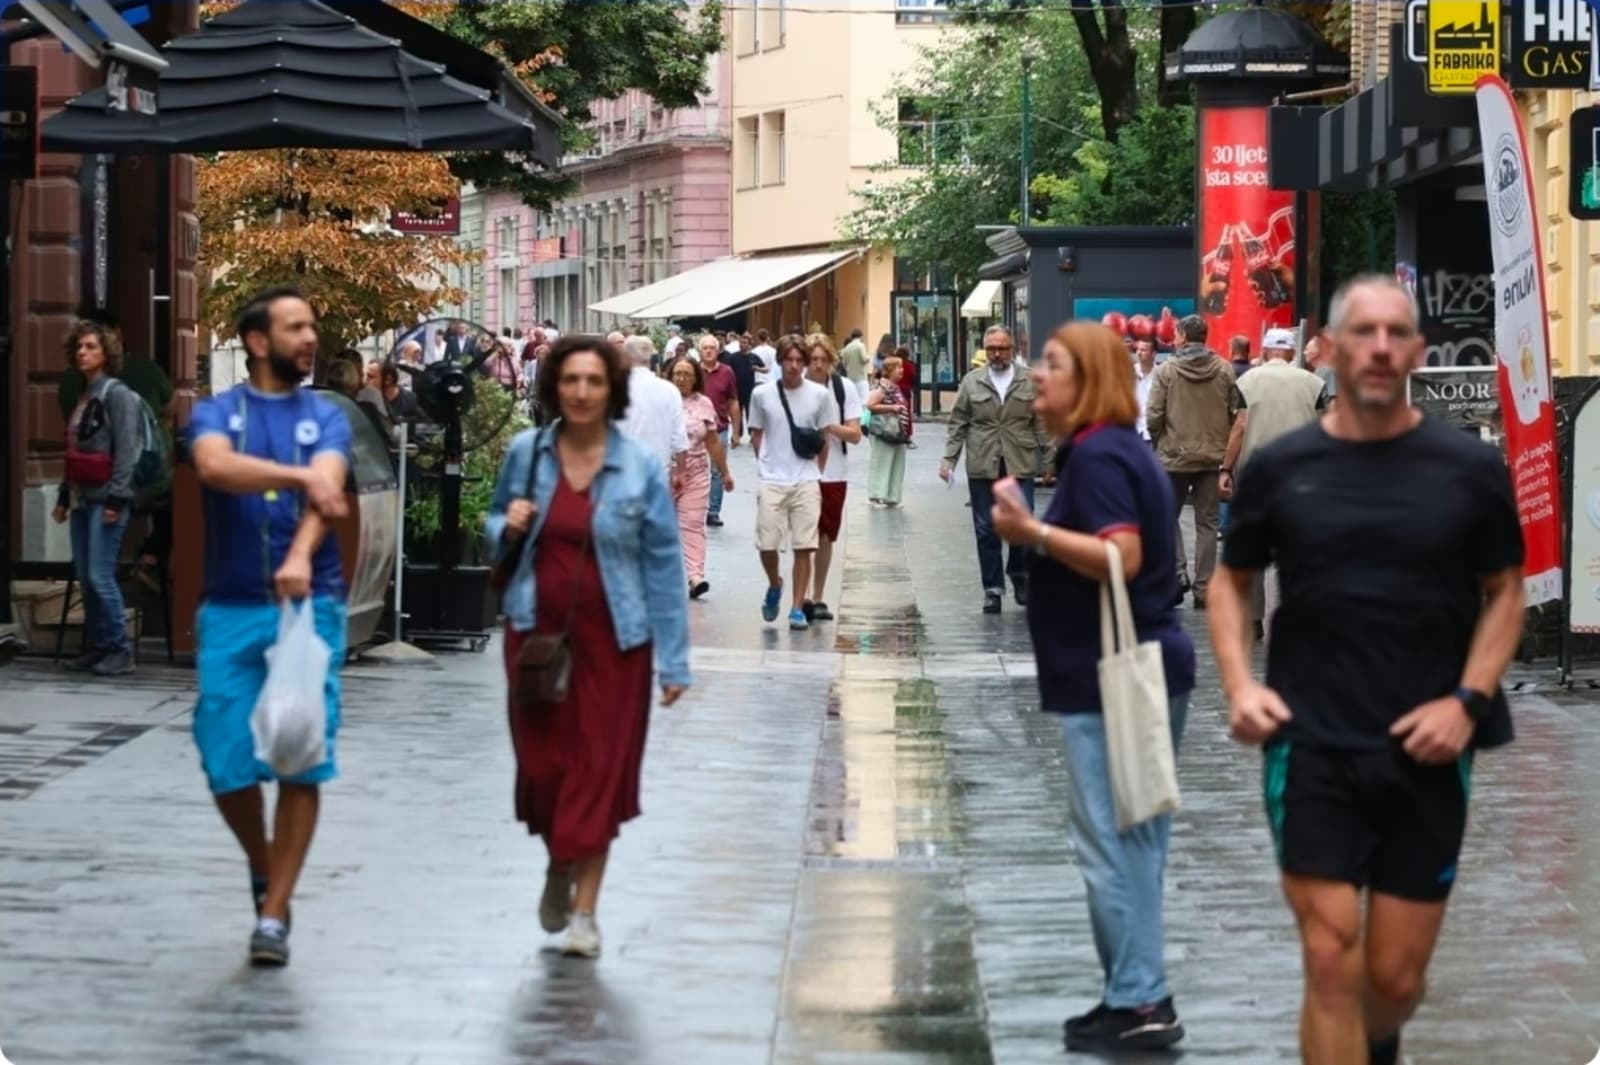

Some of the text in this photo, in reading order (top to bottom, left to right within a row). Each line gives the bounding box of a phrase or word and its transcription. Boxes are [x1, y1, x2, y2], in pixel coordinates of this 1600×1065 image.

[1434, 53, 1495, 70] FABRIKA
[1523, 46, 1590, 77] GAS
[1212, 145, 1233, 164] 30
[1426, 383, 1491, 400] NOOR
